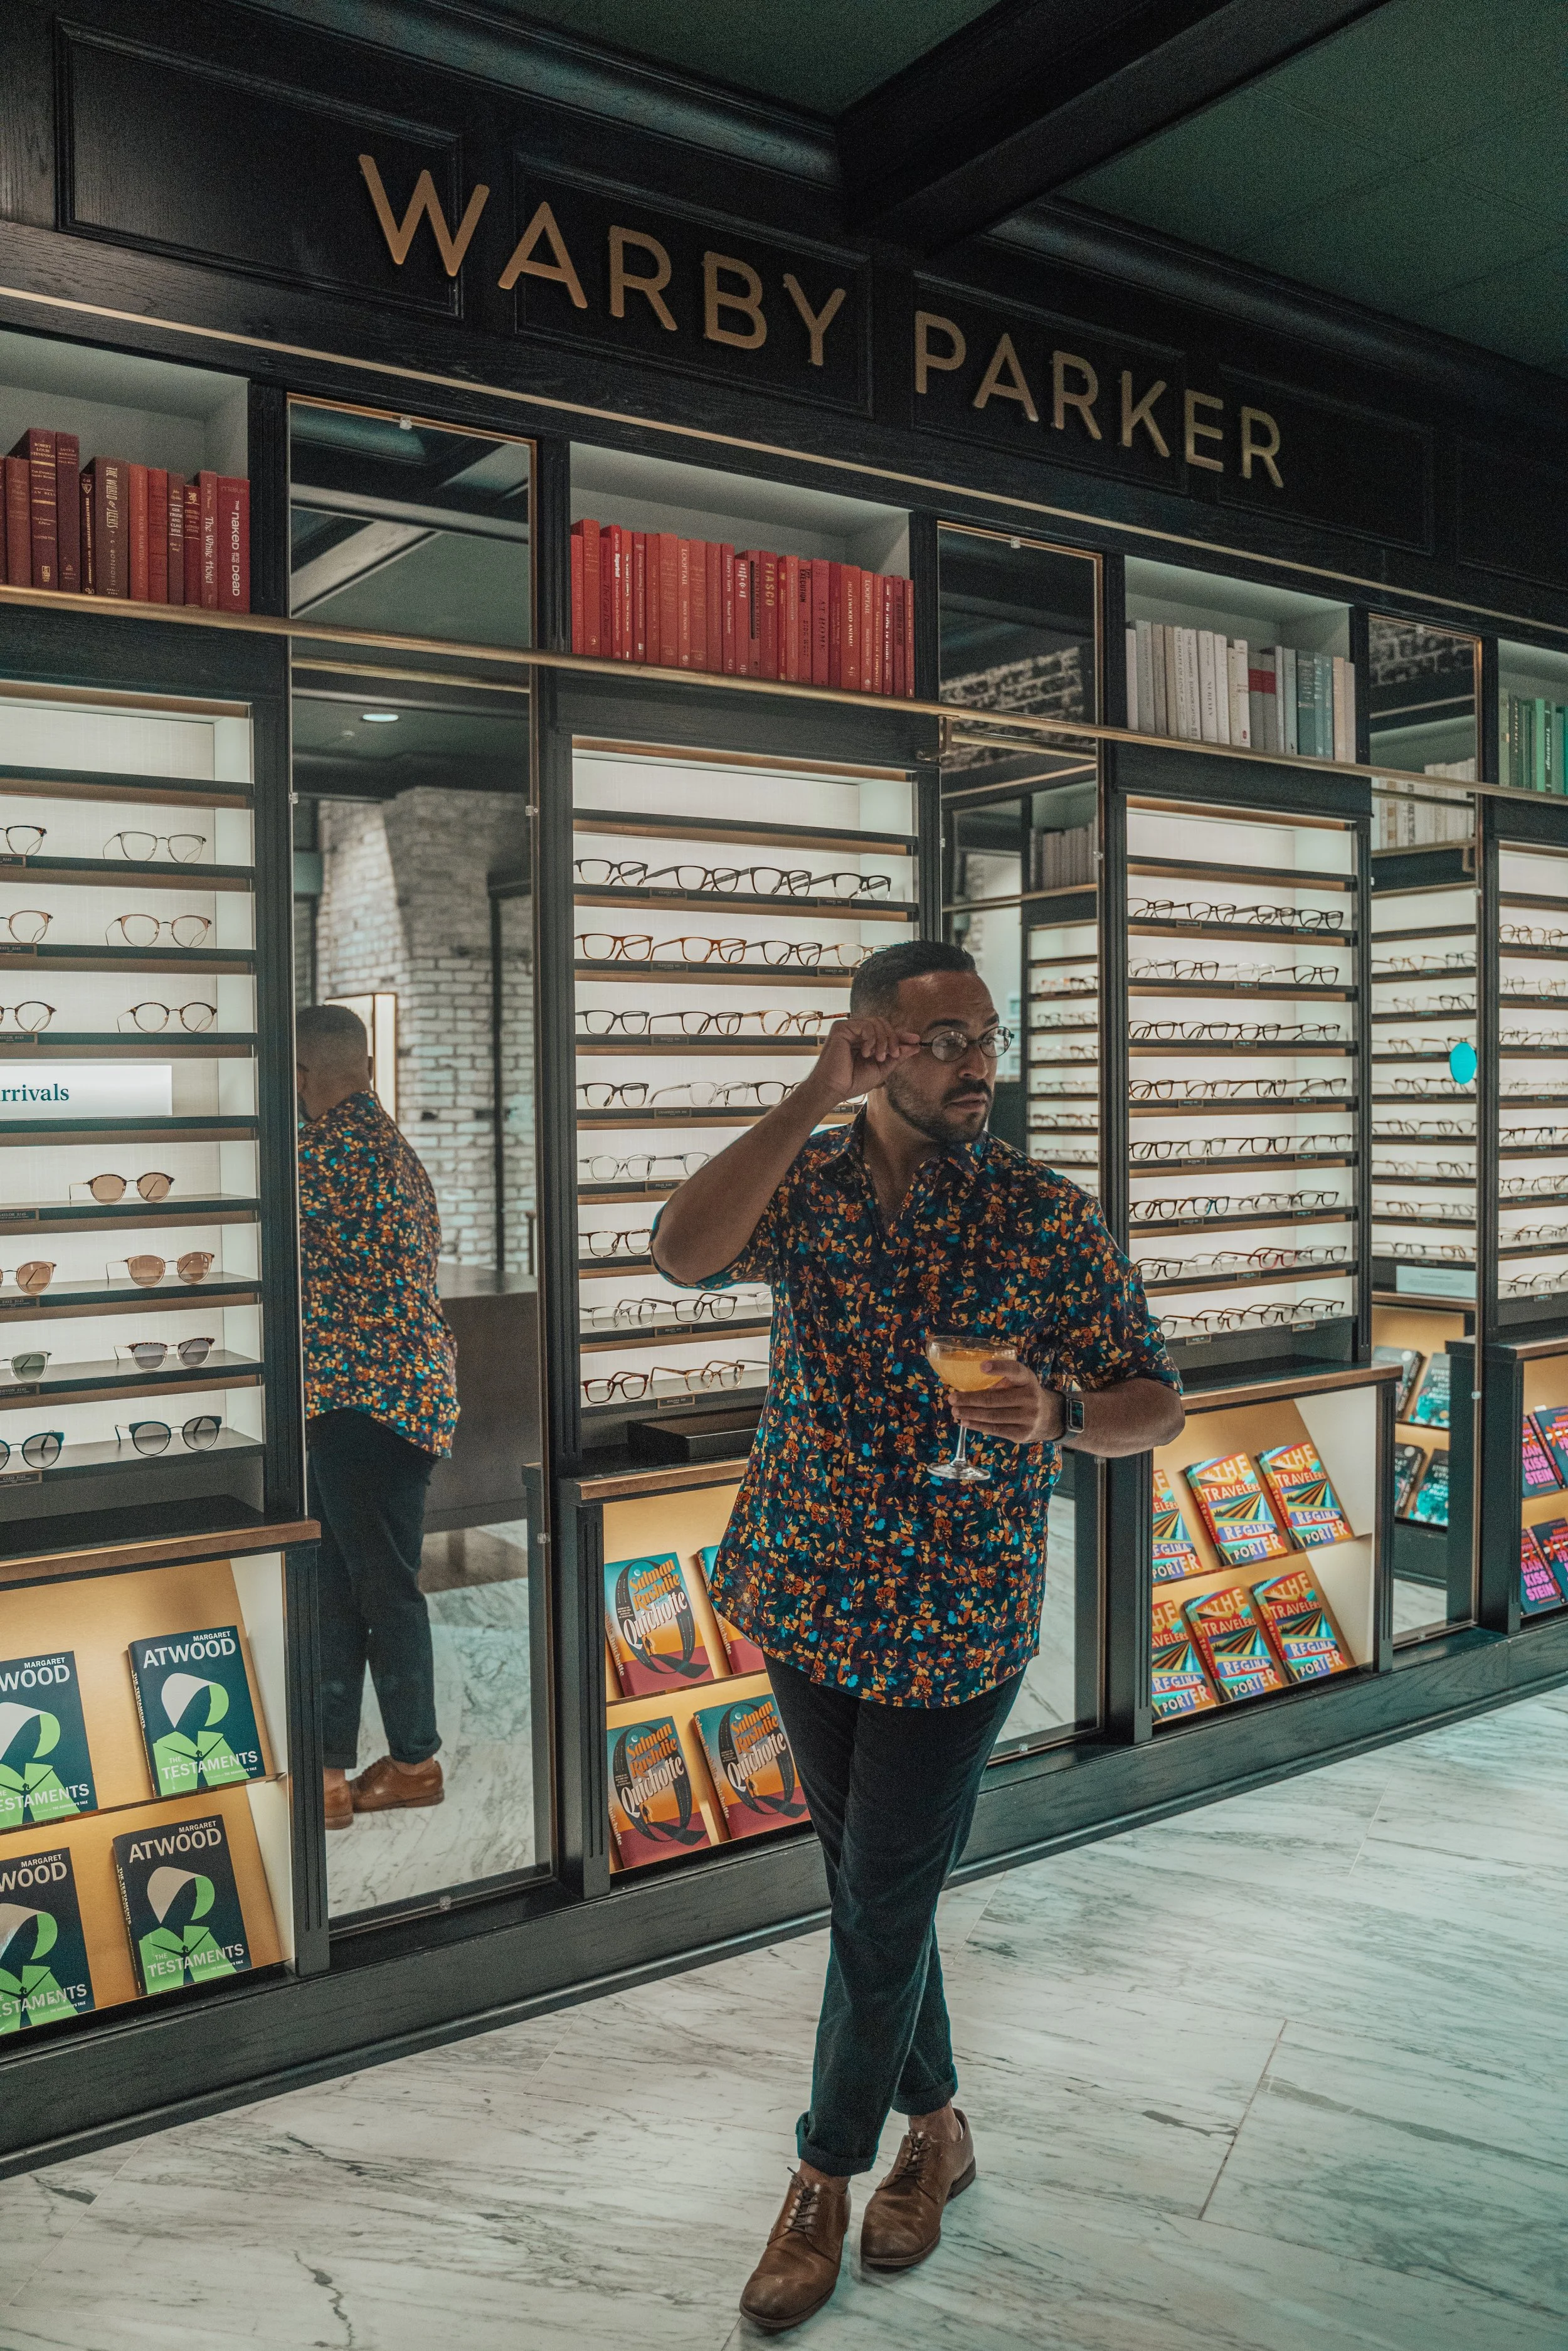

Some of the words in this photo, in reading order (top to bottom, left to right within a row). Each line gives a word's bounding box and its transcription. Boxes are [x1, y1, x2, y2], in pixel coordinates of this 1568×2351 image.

[359, 154, 846, 366] WARBY
[914, 310, 1284, 488] PARKER
[107, 467, 118, 478] THE
[106, 479, 118, 500] WORLD
[107, 507, 119, 528] JEEVES
[205, 516, 214, 531] The
[205, 535, 214, 558] White
[206, 561, 214, 584] Hotel
[765, 563, 775, 606] FIASCO
[0, 1084, 70, 1101] rrivals
[1281, 1444, 1315, 1467] THE
[1522, 1444, 1544, 1458] RAN
[1212, 1454, 1249, 1479] THE
[1523, 1455, 1549, 1472] KISS
[1274, 1472, 1327, 1489] TRAVELERS
[1525, 1468, 1555, 1485] STEIN
[1202, 1484, 1261, 1502] TRAVELERS
[1156, 1502, 1178, 1513] ELERS
[1296, 1510, 1338, 1525] REGINA
[1223, 1524, 1274, 1541] REGINA
[1305, 1520, 1348, 1544] PORTER
[1152, 1543, 1192, 1558] EGINA
[1233, 1534, 1283, 1560] PORTER
[629, 1559, 676, 1595] Salman
[1152, 1554, 1200, 1578] PORTER
[1521, 1559, 1544, 1574] RAN
[1277, 1573, 1310, 1596] THE
[1523, 1570, 1549, 1588] KISS
[632, 1573, 681, 1611] Rushdie
[1210, 1588, 1246, 1614] THE
[1526, 1583, 1556, 1601] STEIN
[623, 1591, 688, 1650] Quichotte
[1152, 1602, 1177, 1627] HE
[1269, 1602, 1321, 1620] TRAVELERS
[193, 1631, 231, 1642] MARGARET
[717, 1616, 732, 1655] Quichotte
[1202, 1618, 1257, 1637] TRAVELERS
[1152, 1633, 1189, 1647] AVELERS
[1290, 1642, 1335, 1657] REGINA
[24, 1657, 65, 1669] MARGARET
[143, 1638, 236, 1669] ATWOOD
[1300, 1650, 1344, 1676] PORTER
[0, 1664, 70, 1692] WOOD
[1222, 1660, 1270, 1676] REGINA
[1153, 1675, 1202, 1692] REGINA
[1232, 1669, 1279, 1696] PORTER
[135, 1683, 146, 1729] TESTAMENTS
[1162, 1685, 1210, 1712] PORTER
[731, 1701, 774, 1738] Salman
[627, 1723, 673, 1760] Salman
[733, 1715, 780, 1754] Rushdie
[161, 1751, 258, 1780] TESTAMENTS
[629, 1738, 678, 1779] Rushdie
[727, 1733, 787, 1792] Quichotte
[621, 1756, 684, 1818] Quichotte
[179, 1820, 216, 1833] MARGARET
[129, 1828, 221, 1864] ATWOOD
[21, 1854, 62, 1868] MARGARET
[0, 1861, 67, 1892] WOOD
[122, 1881, 132, 1924] TESTAMENTS
[147, 1943, 245, 1977] TESTAMENTS
[0, 1984, 87, 2017] STAMENTS
